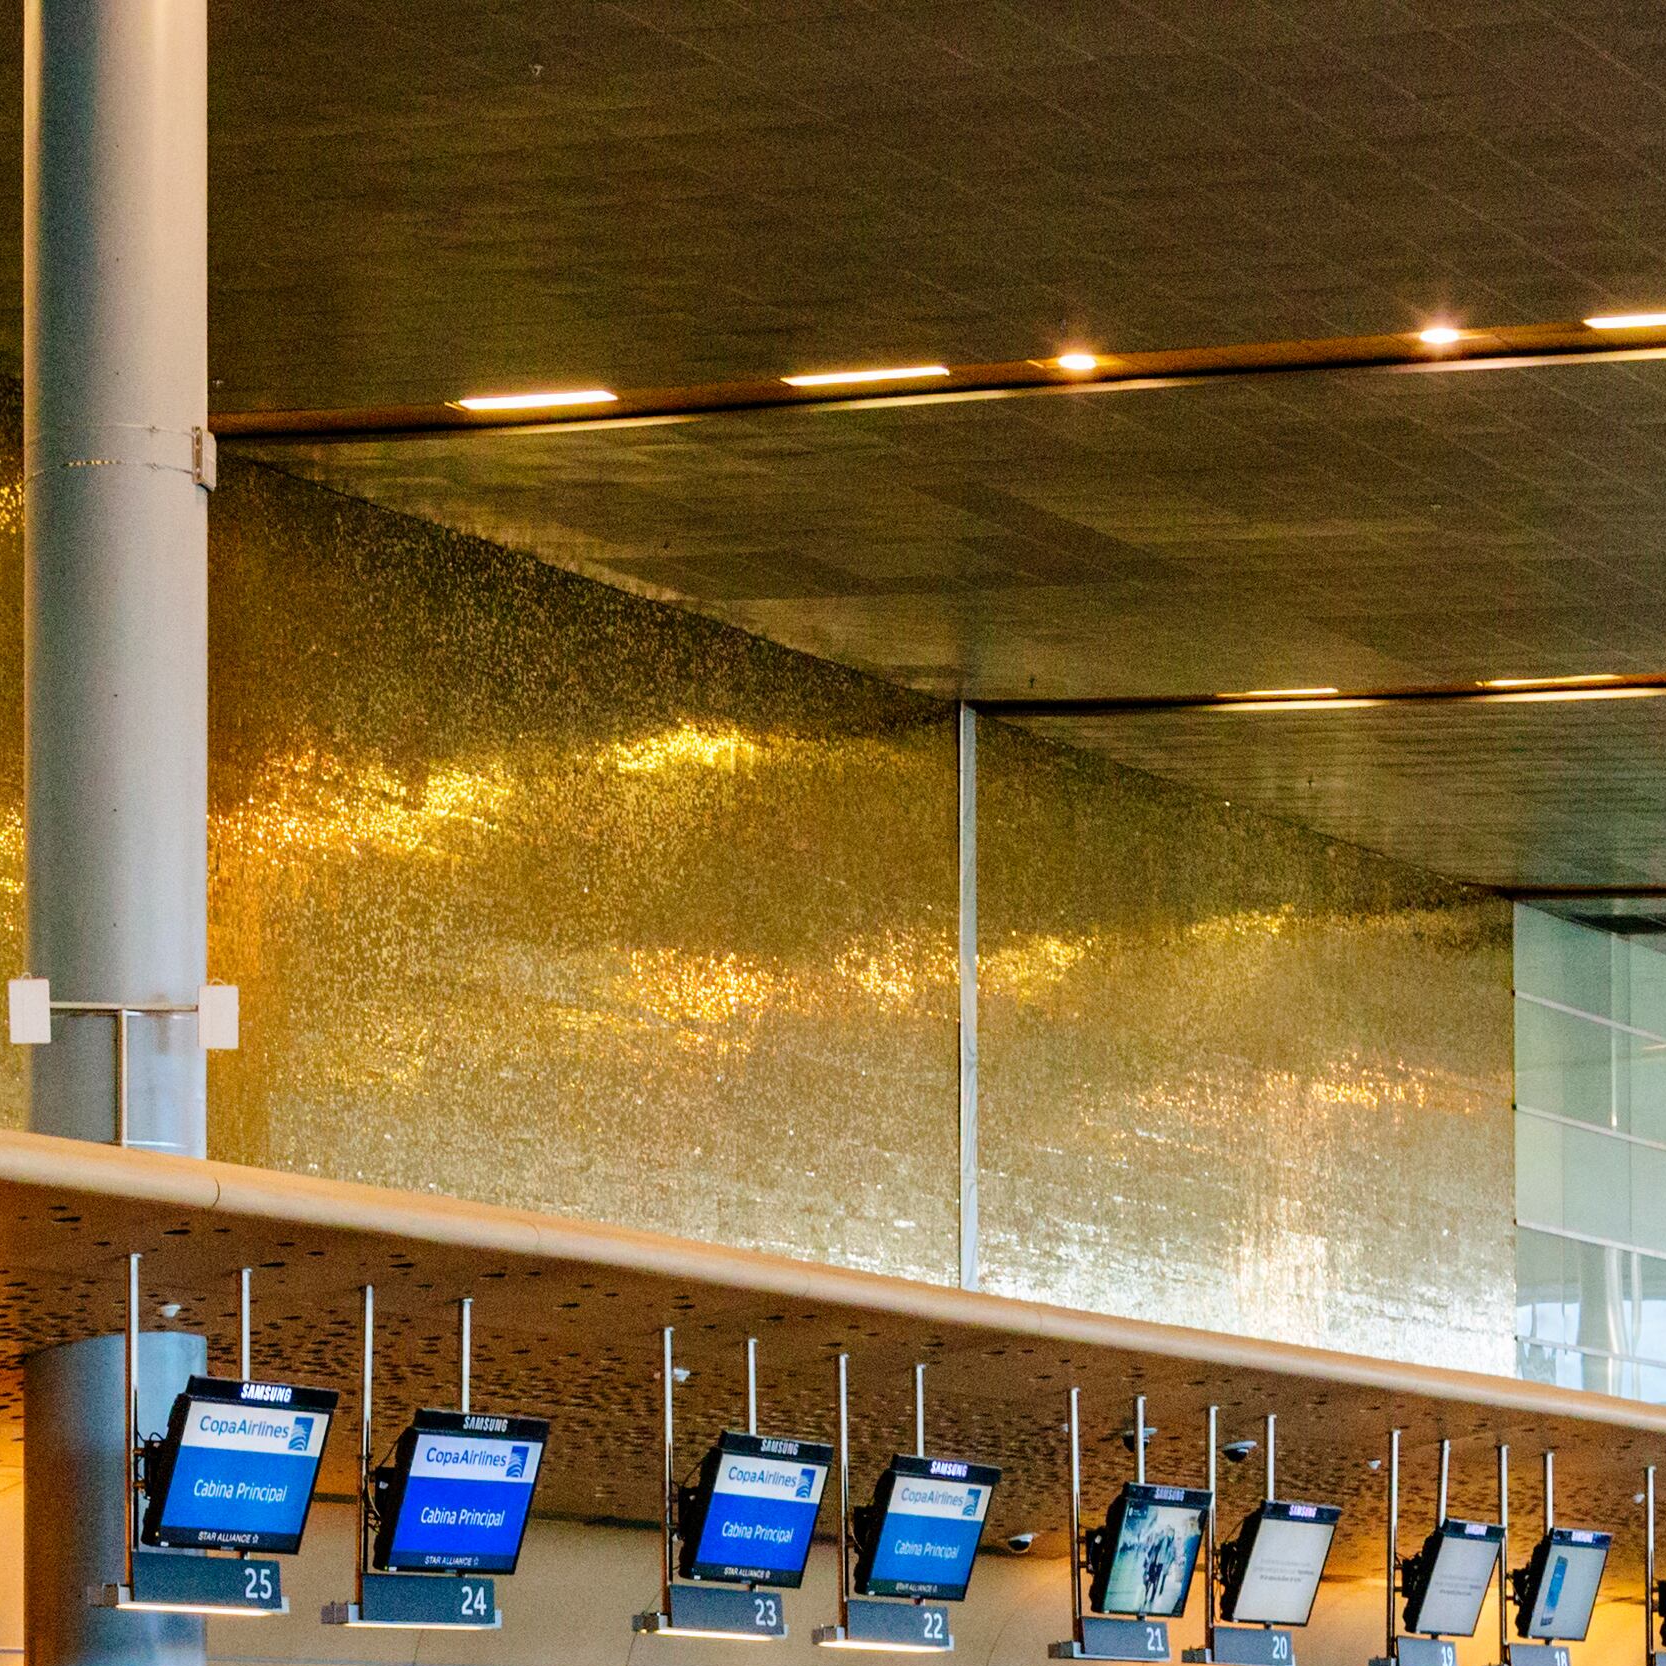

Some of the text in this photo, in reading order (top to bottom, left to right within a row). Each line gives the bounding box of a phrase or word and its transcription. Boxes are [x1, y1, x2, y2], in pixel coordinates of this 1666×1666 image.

[241, 1382, 292, 1403] SAMSUNG
[463, 1415, 508, 1433] SAMSUNG
[760, 1439, 799, 1456] SAMSUNG
[930, 1461, 968, 1478] SAMSUNG
[193, 1478, 287, 1504] Cabina Principal
[420, 1505, 505, 1530] Cabina Principal
[198, 1531, 252, 1545] STAR ALLIANCE
[722, 1521, 794, 1545] Cabina Principal
[424, 1555, 473, 1567] STAR ALLIANCE
[894, 1540, 960, 1559] Cabina Principal
[244, 1568, 272, 1599] 25
[461, 1586, 486, 1616] 24
[755, 1599, 777, 1627] 23
[923, 1612, 944, 1640] 22
[1146, 1627, 1165, 1652] 21
[1272, 1636, 1287, 1660] 20
